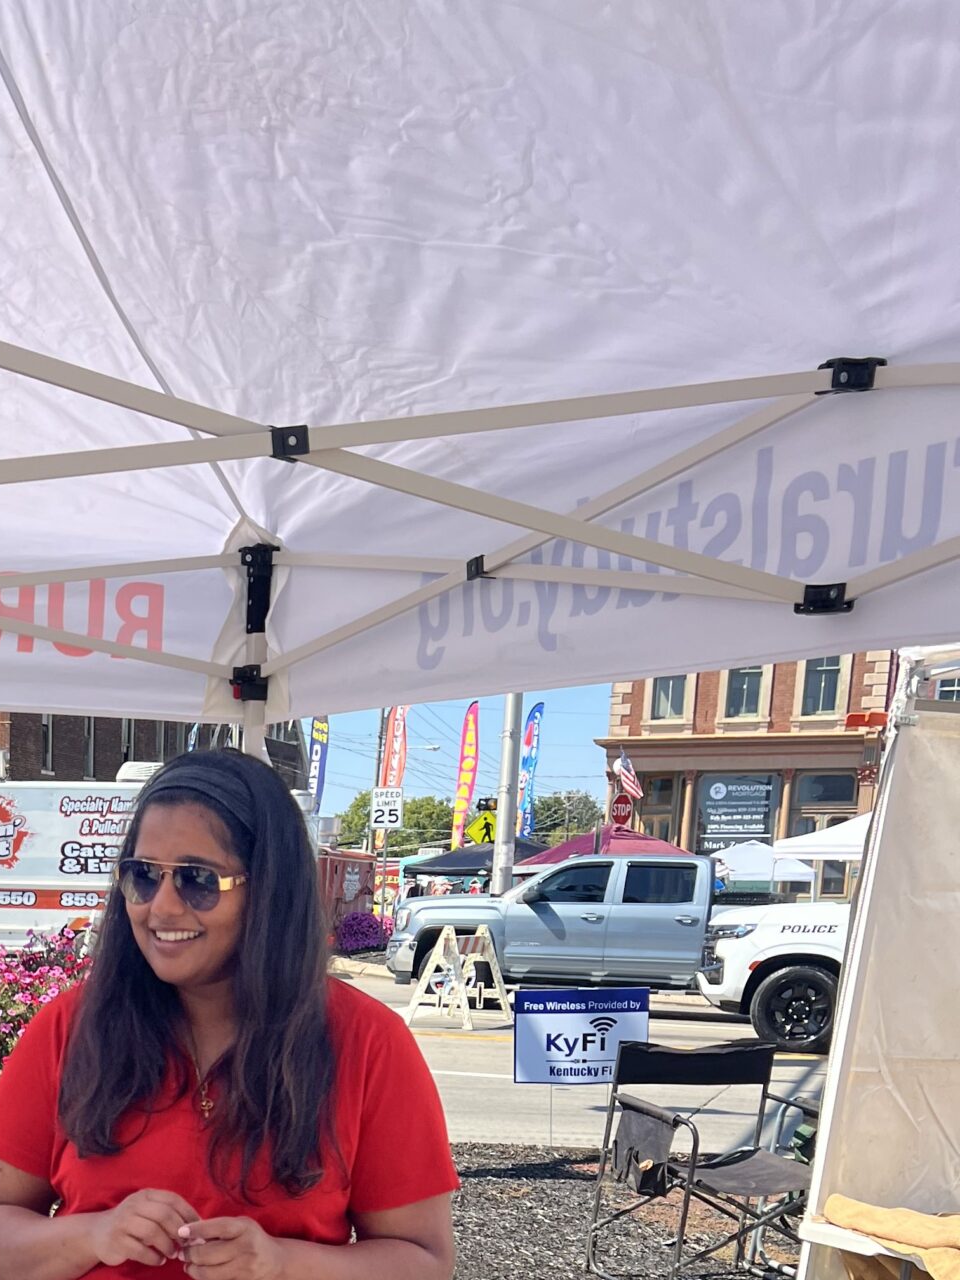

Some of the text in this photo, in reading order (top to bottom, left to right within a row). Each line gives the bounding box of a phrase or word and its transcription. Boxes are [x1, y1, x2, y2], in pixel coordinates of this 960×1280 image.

[61, 796, 110, 816] Specialty
[612, 803, 631, 817] STOP
[373, 809, 399, 824] 25
[91, 819, 123, 834] Pulled
[703, 841, 726, 849] Mark
[780, 925, 839, 934] POLICE
[524, 1000, 641, 1011] Free Wireless Provided by
[546, 1032, 606, 1057] KyFi
[549, 1066, 599, 1077] Kentucky
